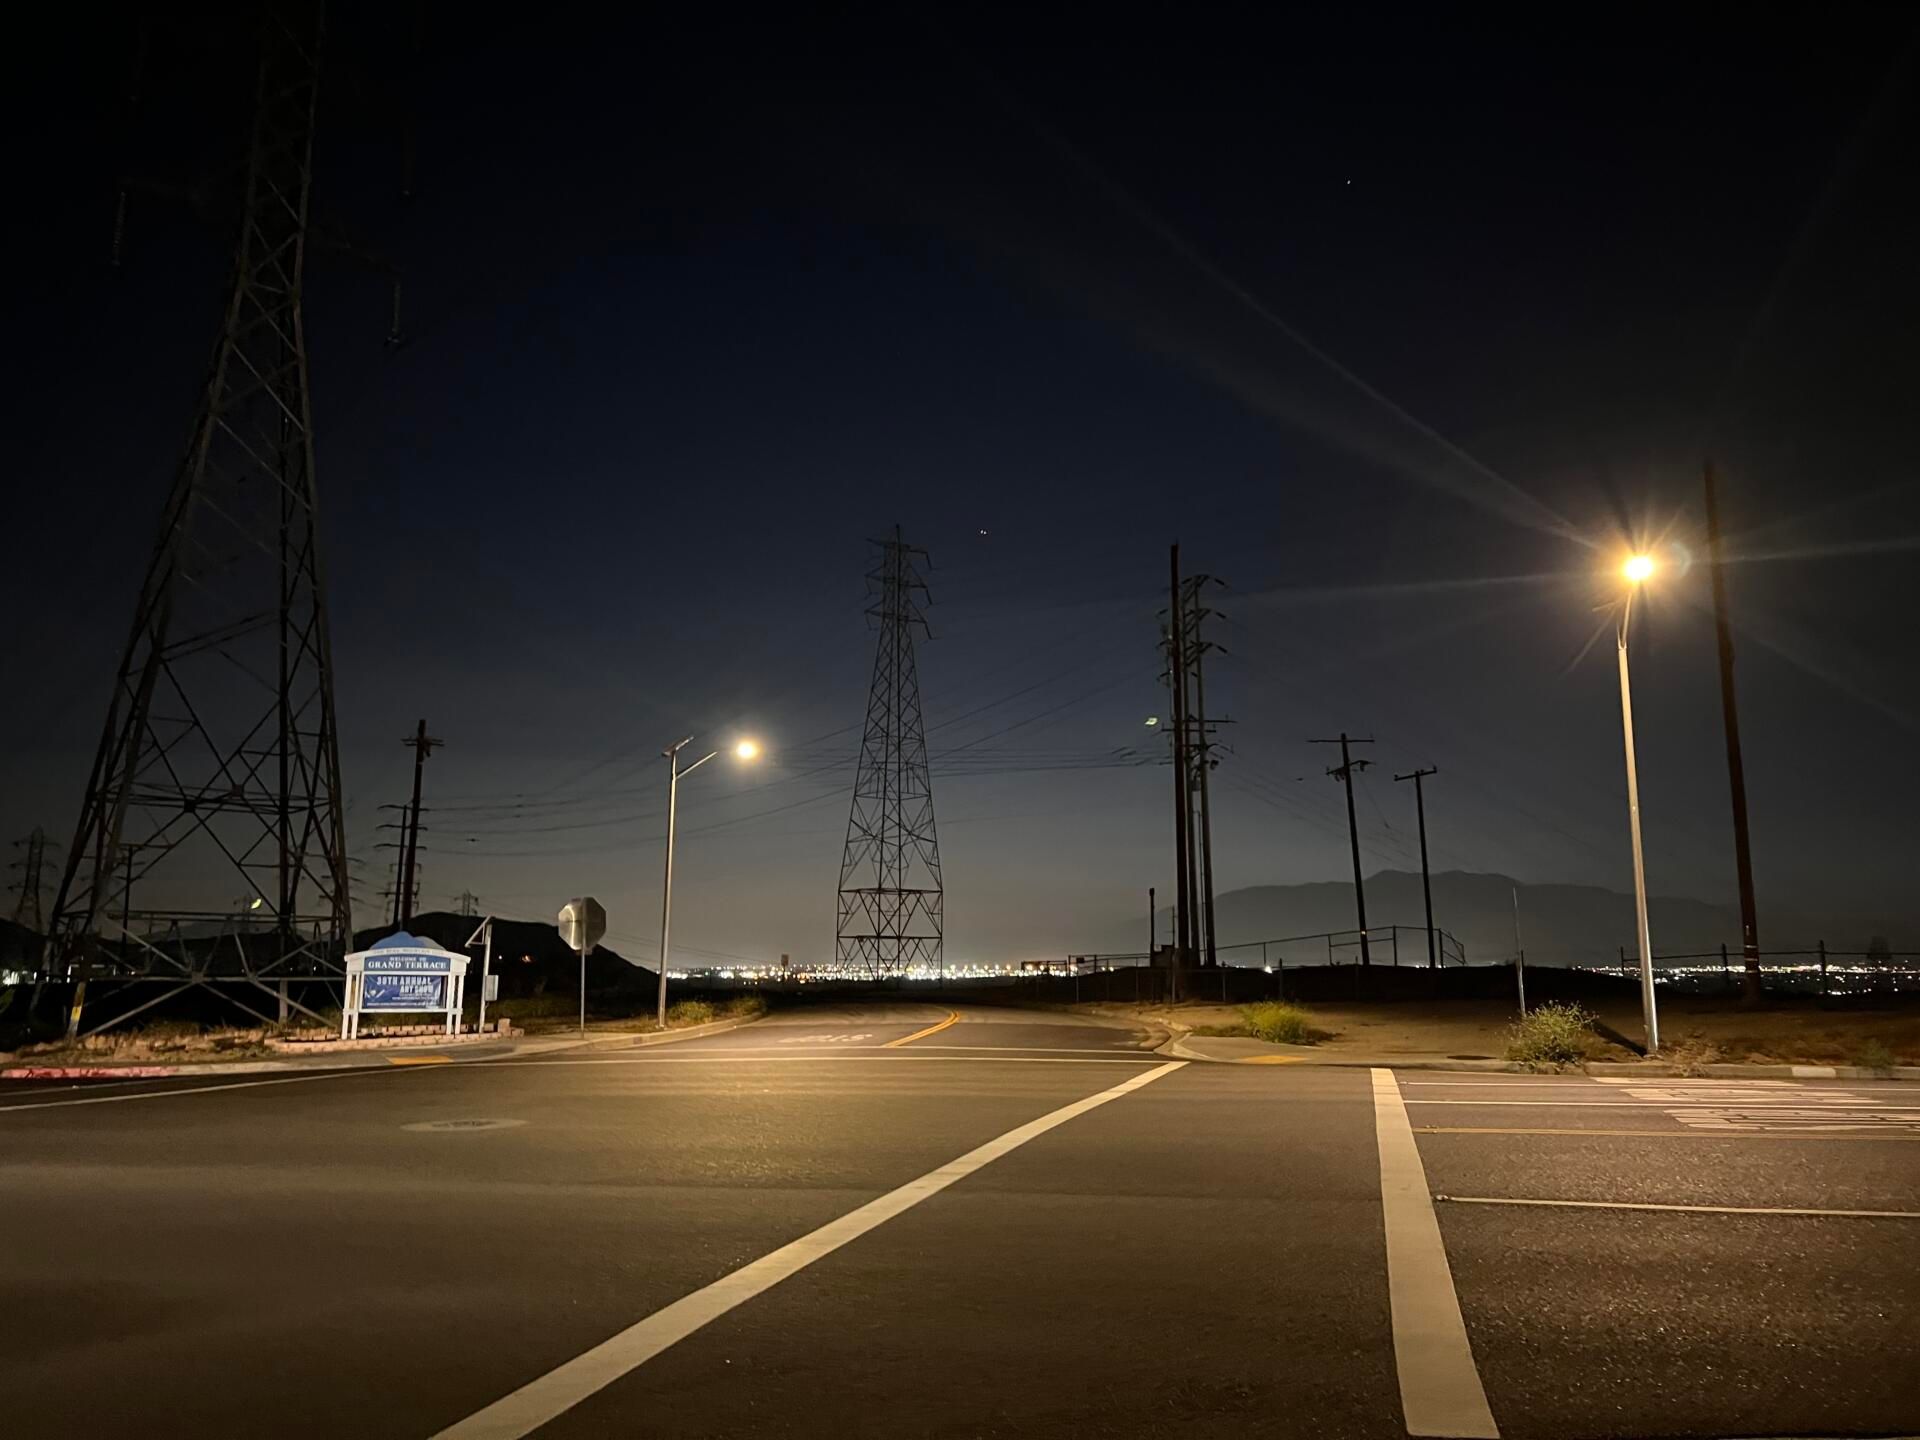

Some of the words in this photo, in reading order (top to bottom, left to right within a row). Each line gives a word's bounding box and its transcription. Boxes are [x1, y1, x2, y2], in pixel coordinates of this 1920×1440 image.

[367, 961, 402, 969] GRAND
[405, 961, 447, 969] TERRACE
[399, 976, 432, 985] ANNUAL
[400, 985, 413, 993] ART
